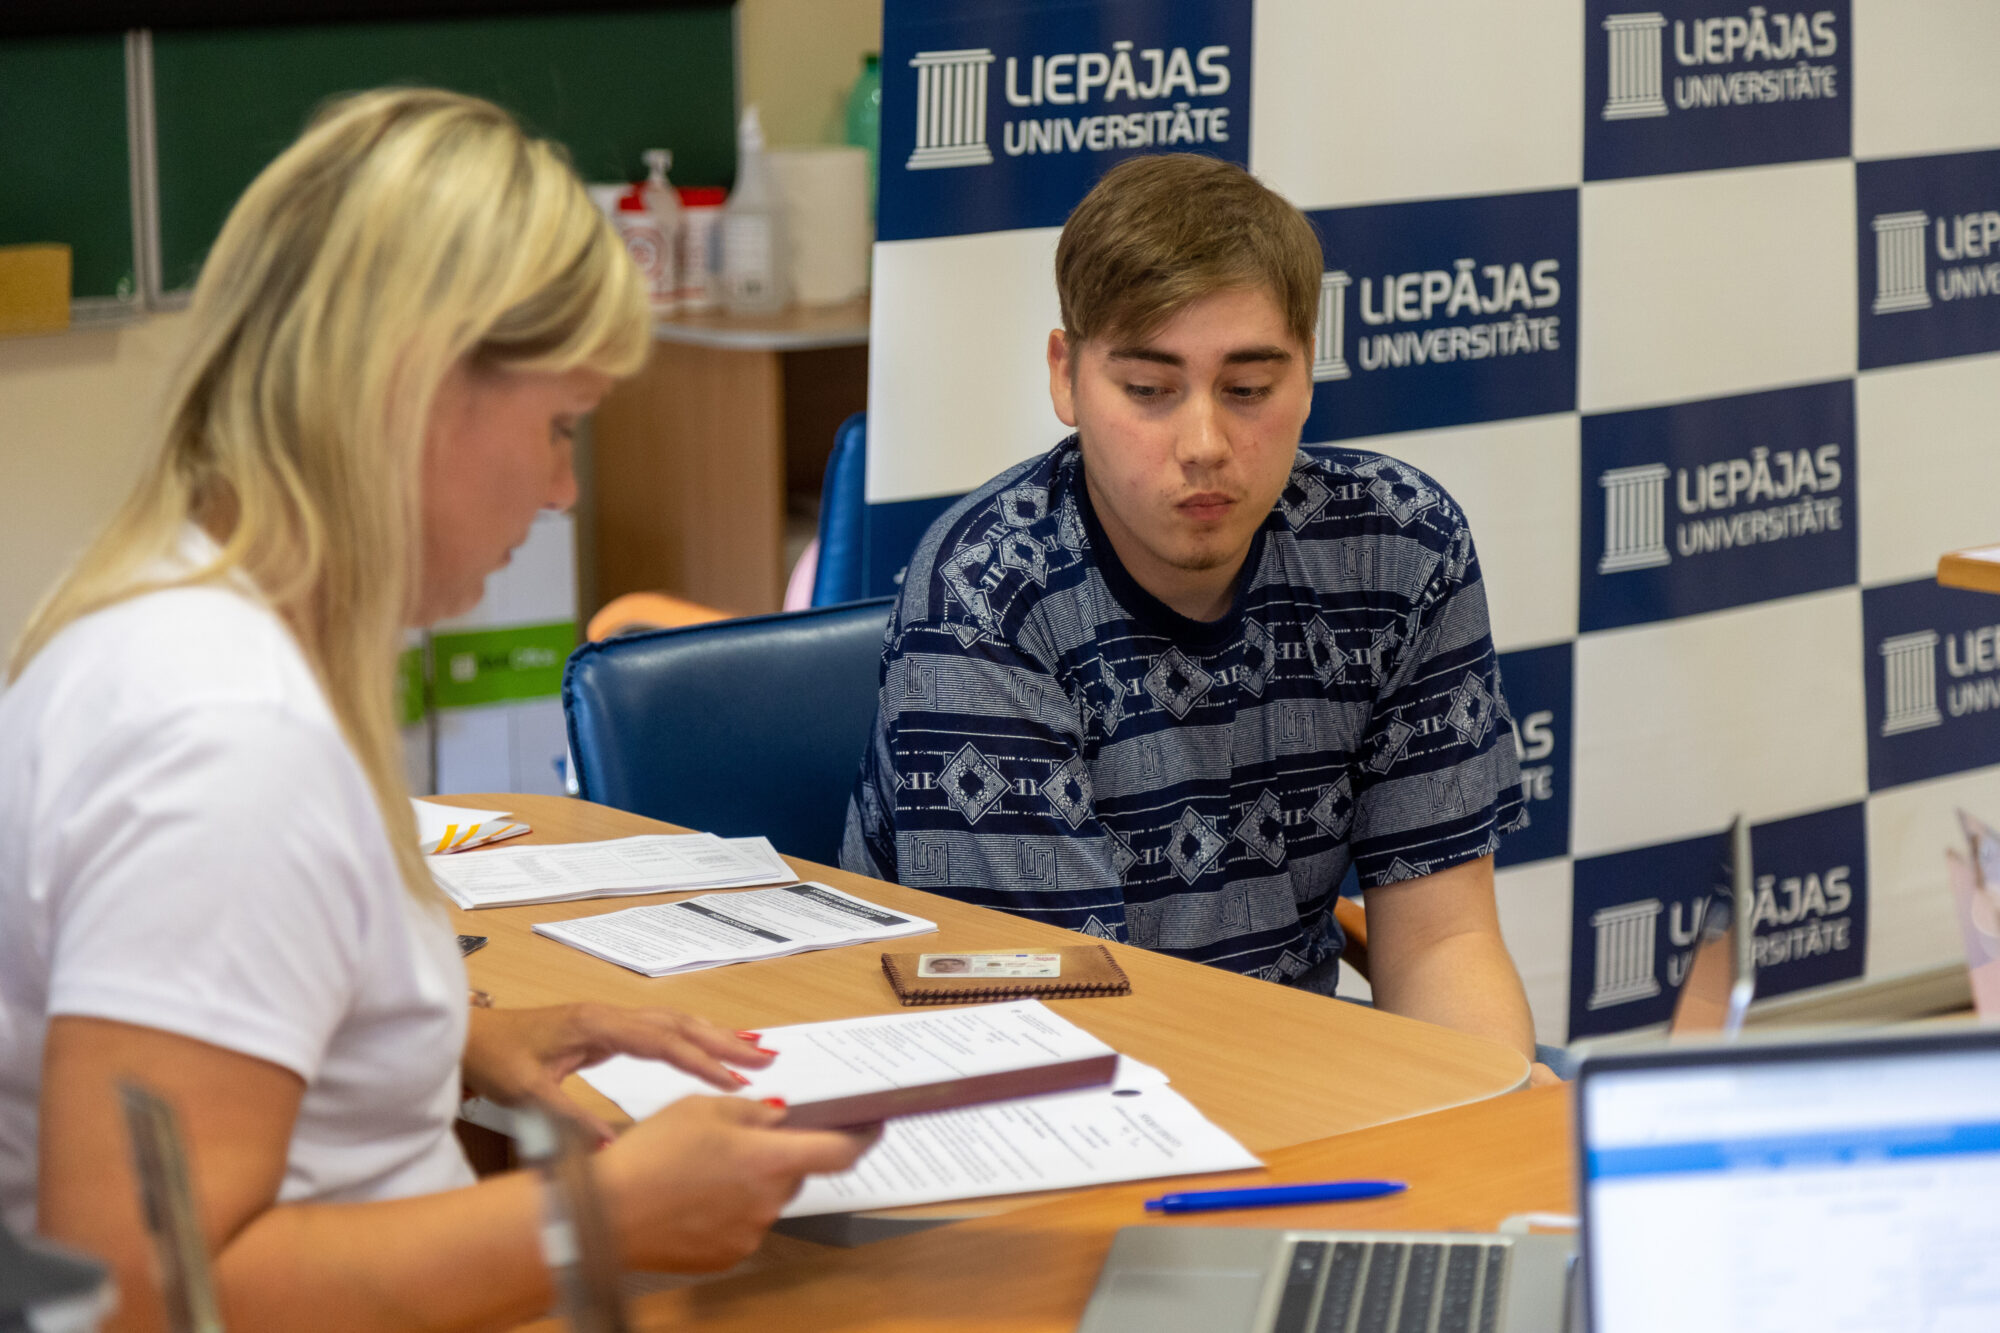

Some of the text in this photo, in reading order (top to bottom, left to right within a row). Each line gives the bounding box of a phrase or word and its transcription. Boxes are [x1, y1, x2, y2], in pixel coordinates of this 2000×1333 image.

[1675, 5, 1838, 66] LIEPĀJAS
[1004, 41, 1232, 107] LIEPĀJAS
[1674, 60, 1838, 110] UNIVERSITĀTE
[1003, 102, 1231, 156] UNIVERSITĀTE
[1936, 211, 2000, 260] LIEP
[1359, 258, 1561, 325] LIEPĀJAS
[1358, 313, 1560, 371] UNIVERSITĀTE
[1677, 443, 1842, 514] LIEPĀJAS
[1676, 494, 1842, 557] UNIVERSITĀTE
